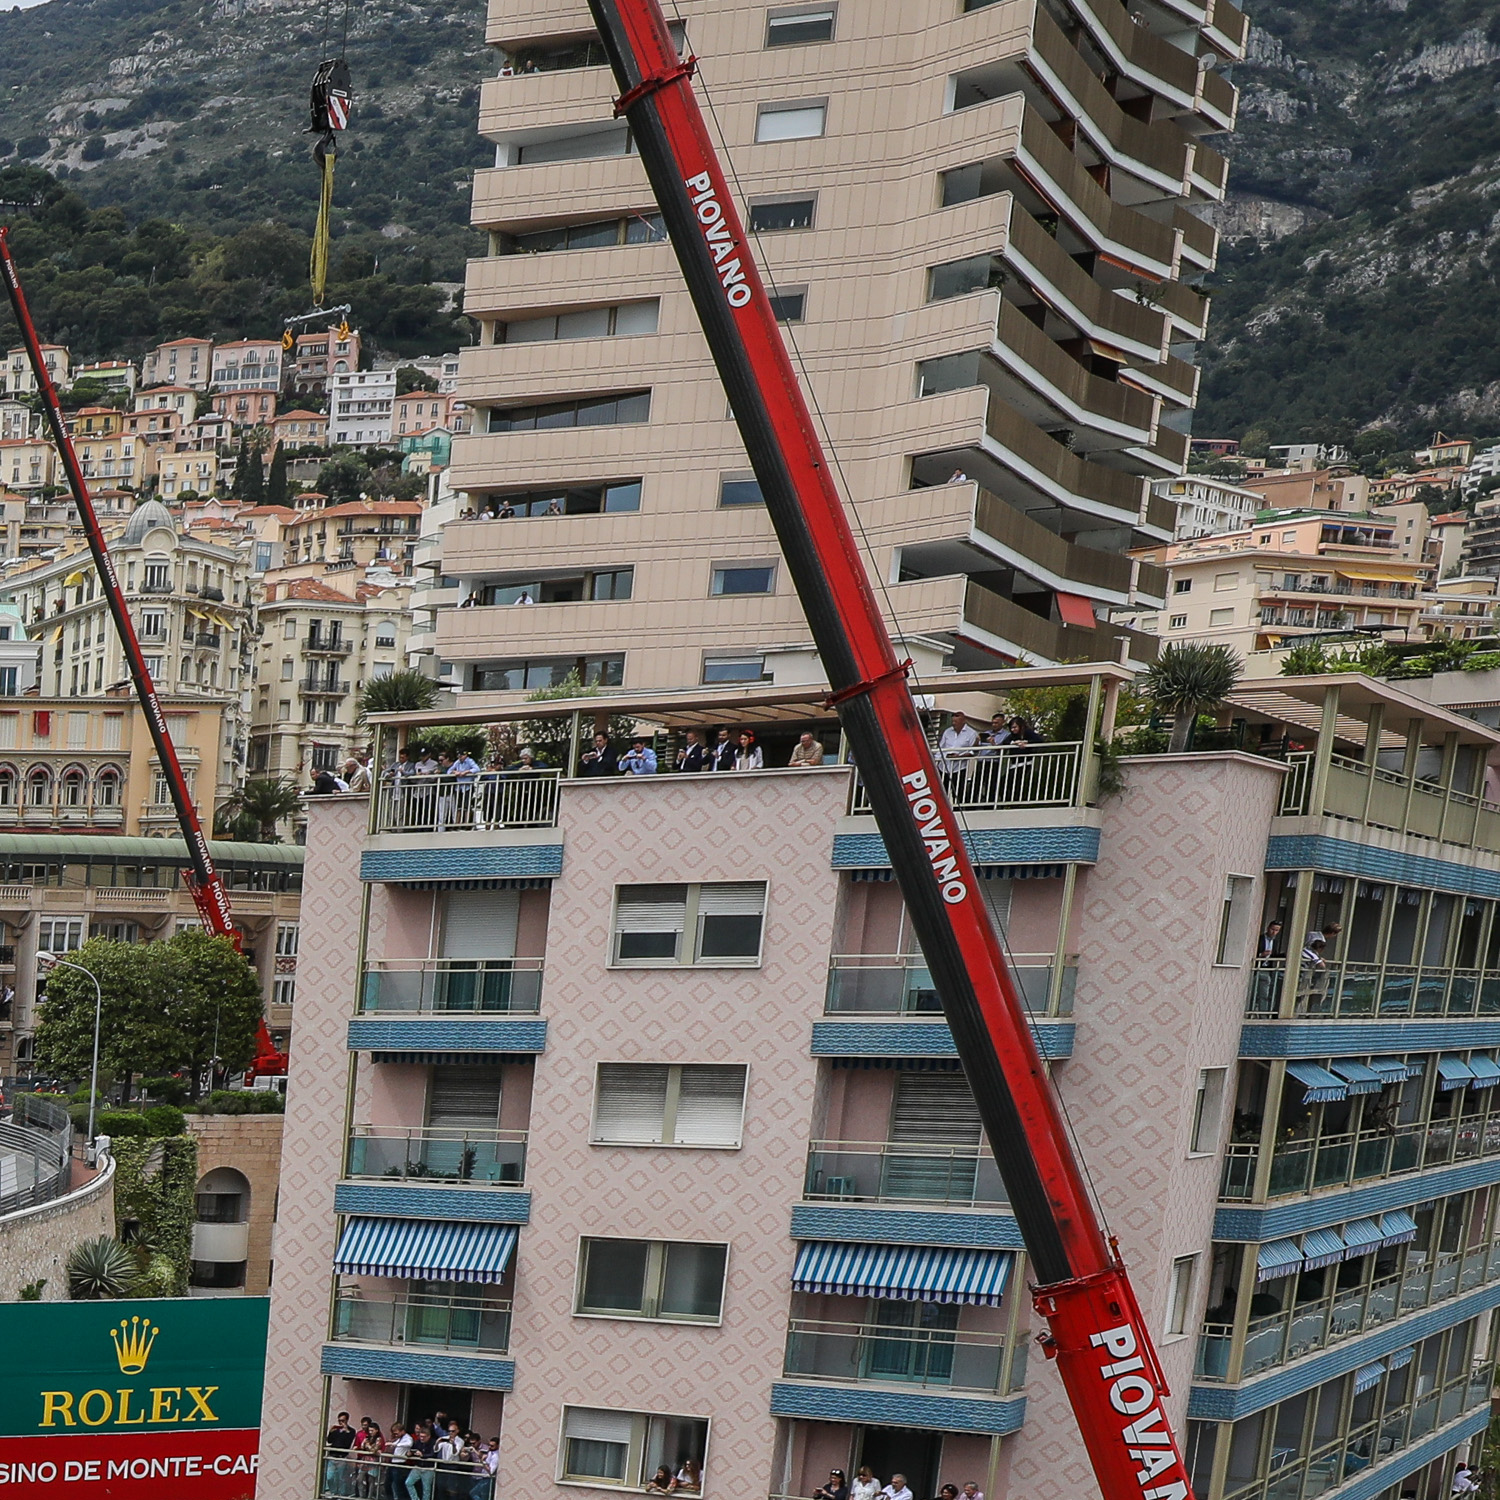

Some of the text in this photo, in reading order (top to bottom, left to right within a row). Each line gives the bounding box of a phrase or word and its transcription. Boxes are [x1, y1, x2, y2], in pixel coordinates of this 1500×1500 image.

[685, 170, 752, 308] PIOVANO
[101, 551, 118, 589] PIOVANO
[148, 692, 166, 734] PIOVANO
[194, 830, 213, 875] PIOVANO
[902, 769, 967, 904] PIOVANO
[211, 880, 233, 931] PIOVANO
[38, 1385, 220, 1428] ROLEX
[63, 1459, 102, 1482] DE
